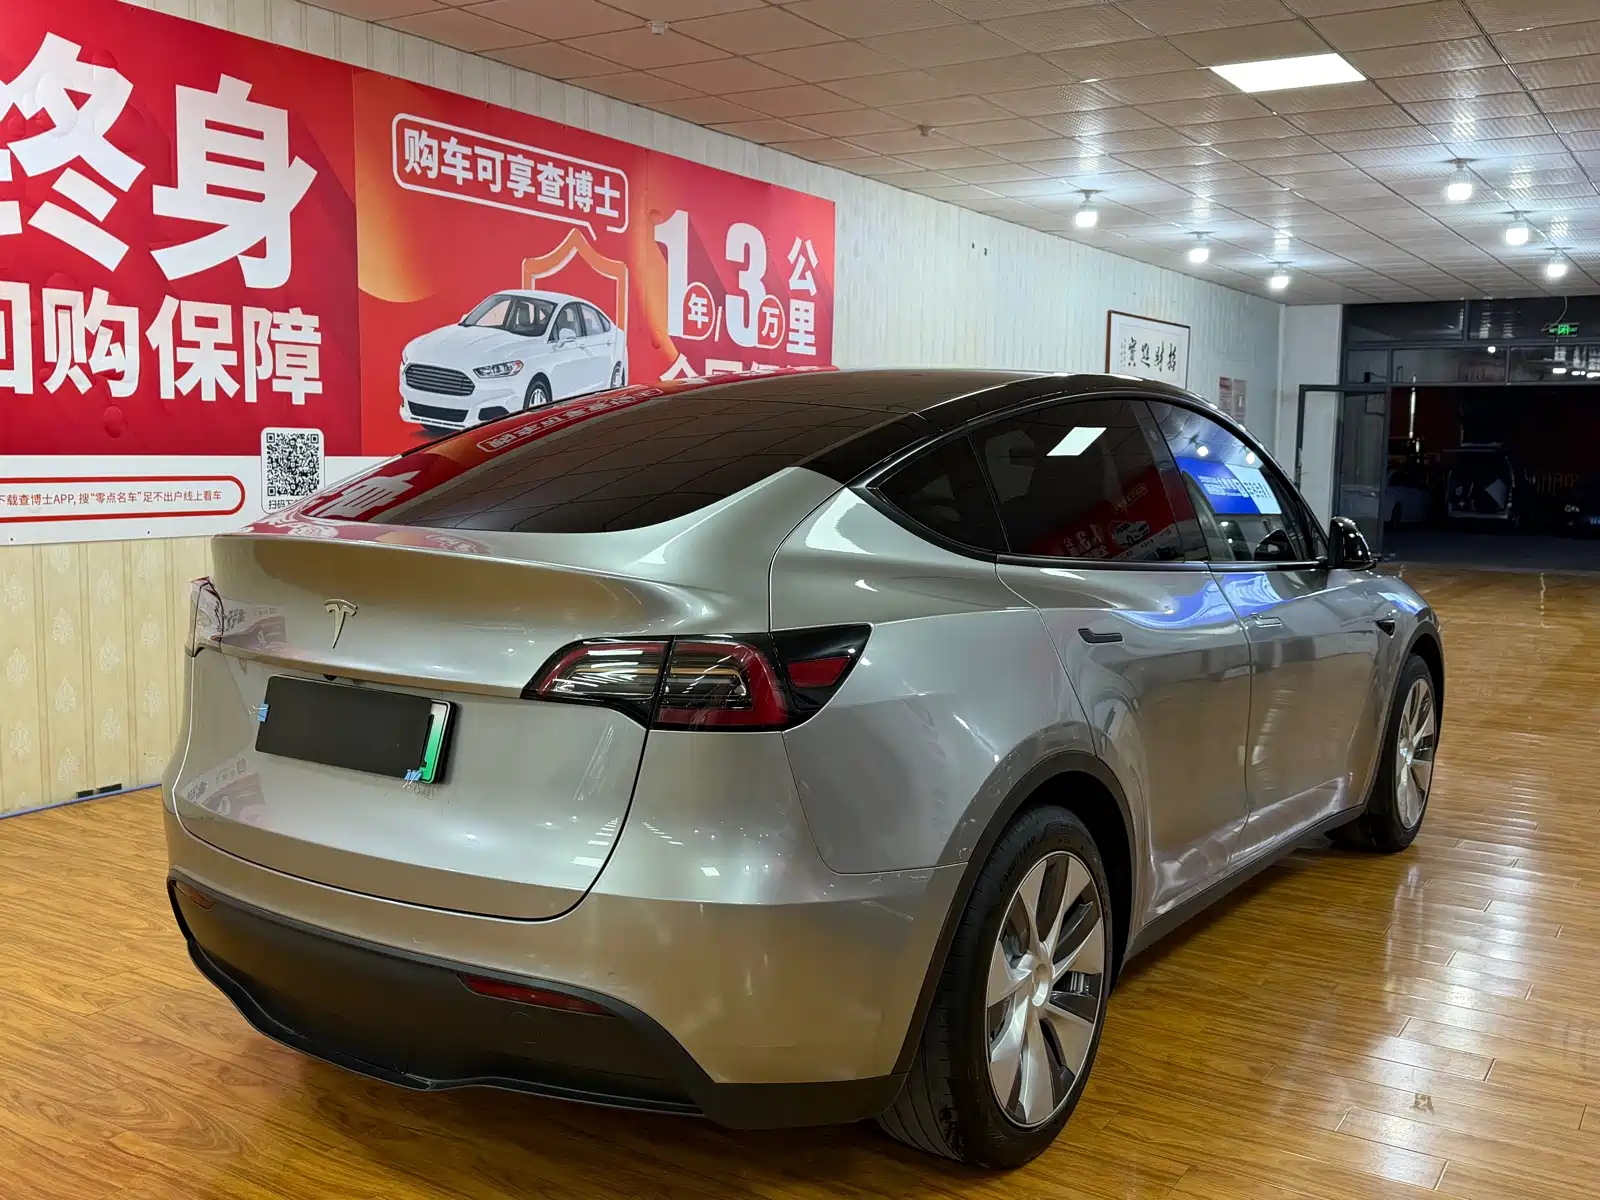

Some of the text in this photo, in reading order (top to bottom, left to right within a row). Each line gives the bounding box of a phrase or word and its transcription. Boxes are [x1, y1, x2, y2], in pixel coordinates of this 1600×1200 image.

[0, 32, 317, 289] 终身
[404, 128, 620, 218] 购车可享查博士
[269, 499, 298, 510] 扫码下
